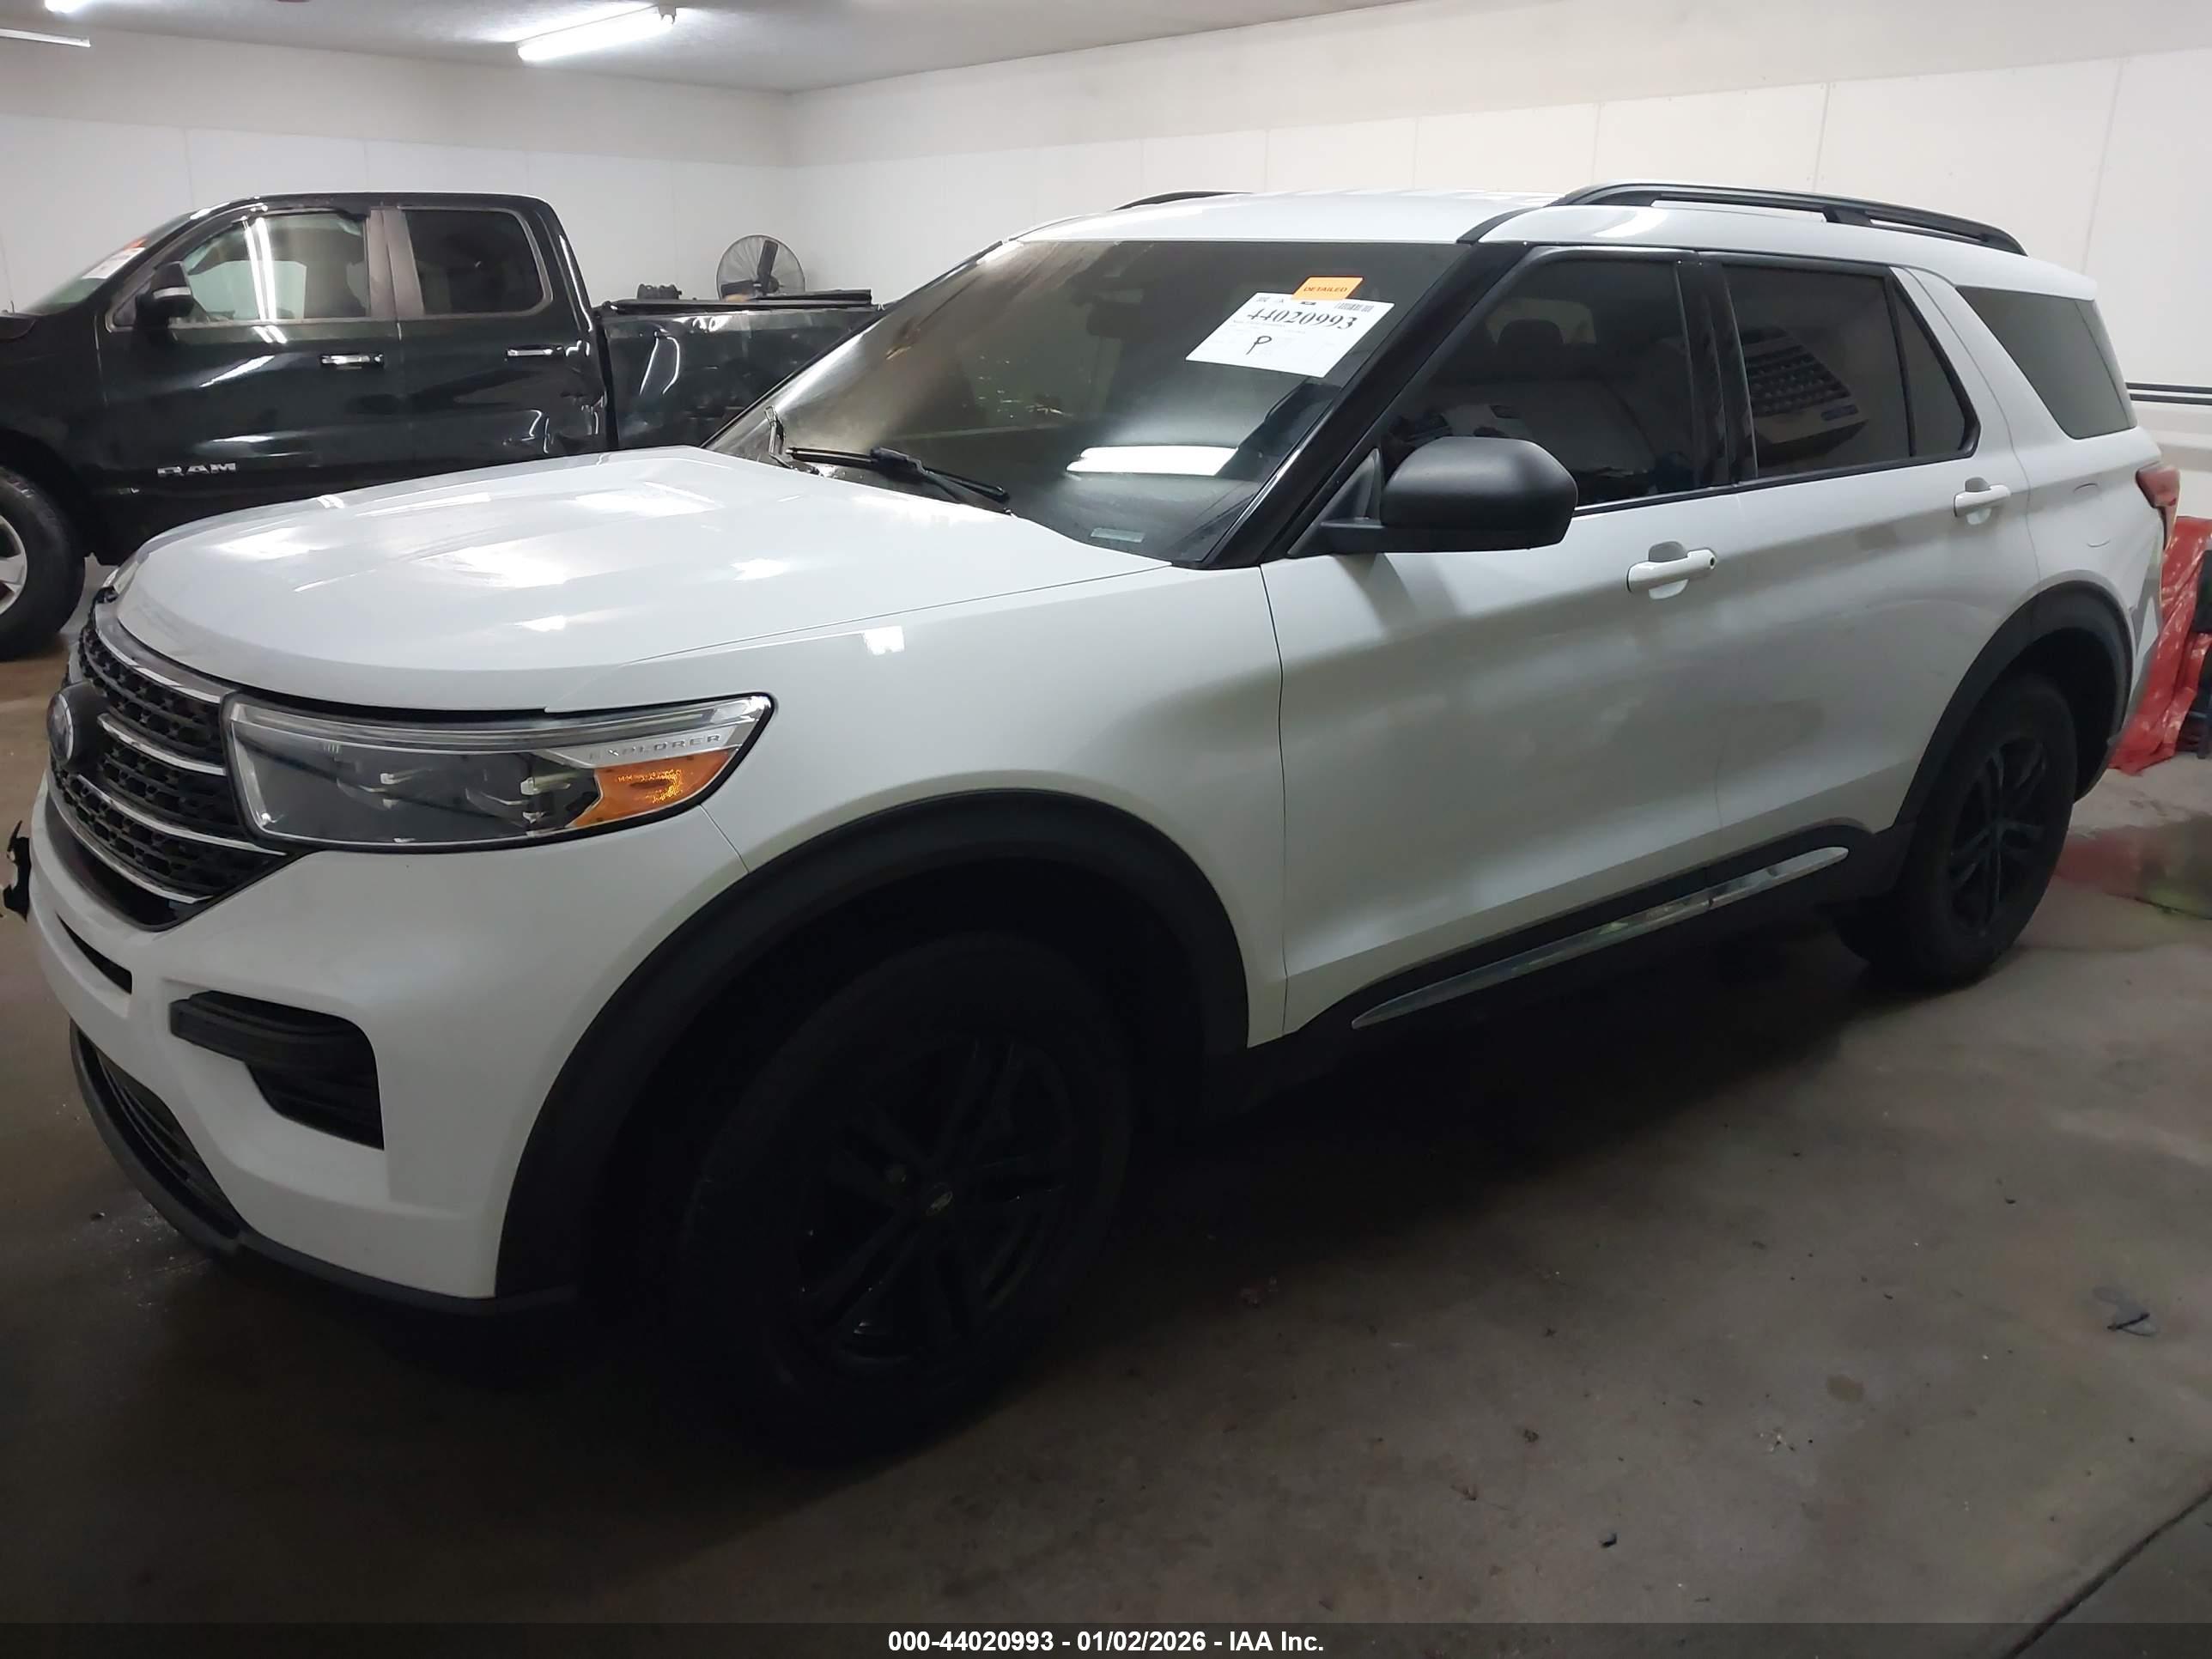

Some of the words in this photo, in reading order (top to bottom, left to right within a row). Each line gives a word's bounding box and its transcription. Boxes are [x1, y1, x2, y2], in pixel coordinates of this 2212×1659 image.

[1247, 307, 1358, 330] 44020993
[1245, 335, 1273, 356] P
[157, 463, 236, 477] RAM
